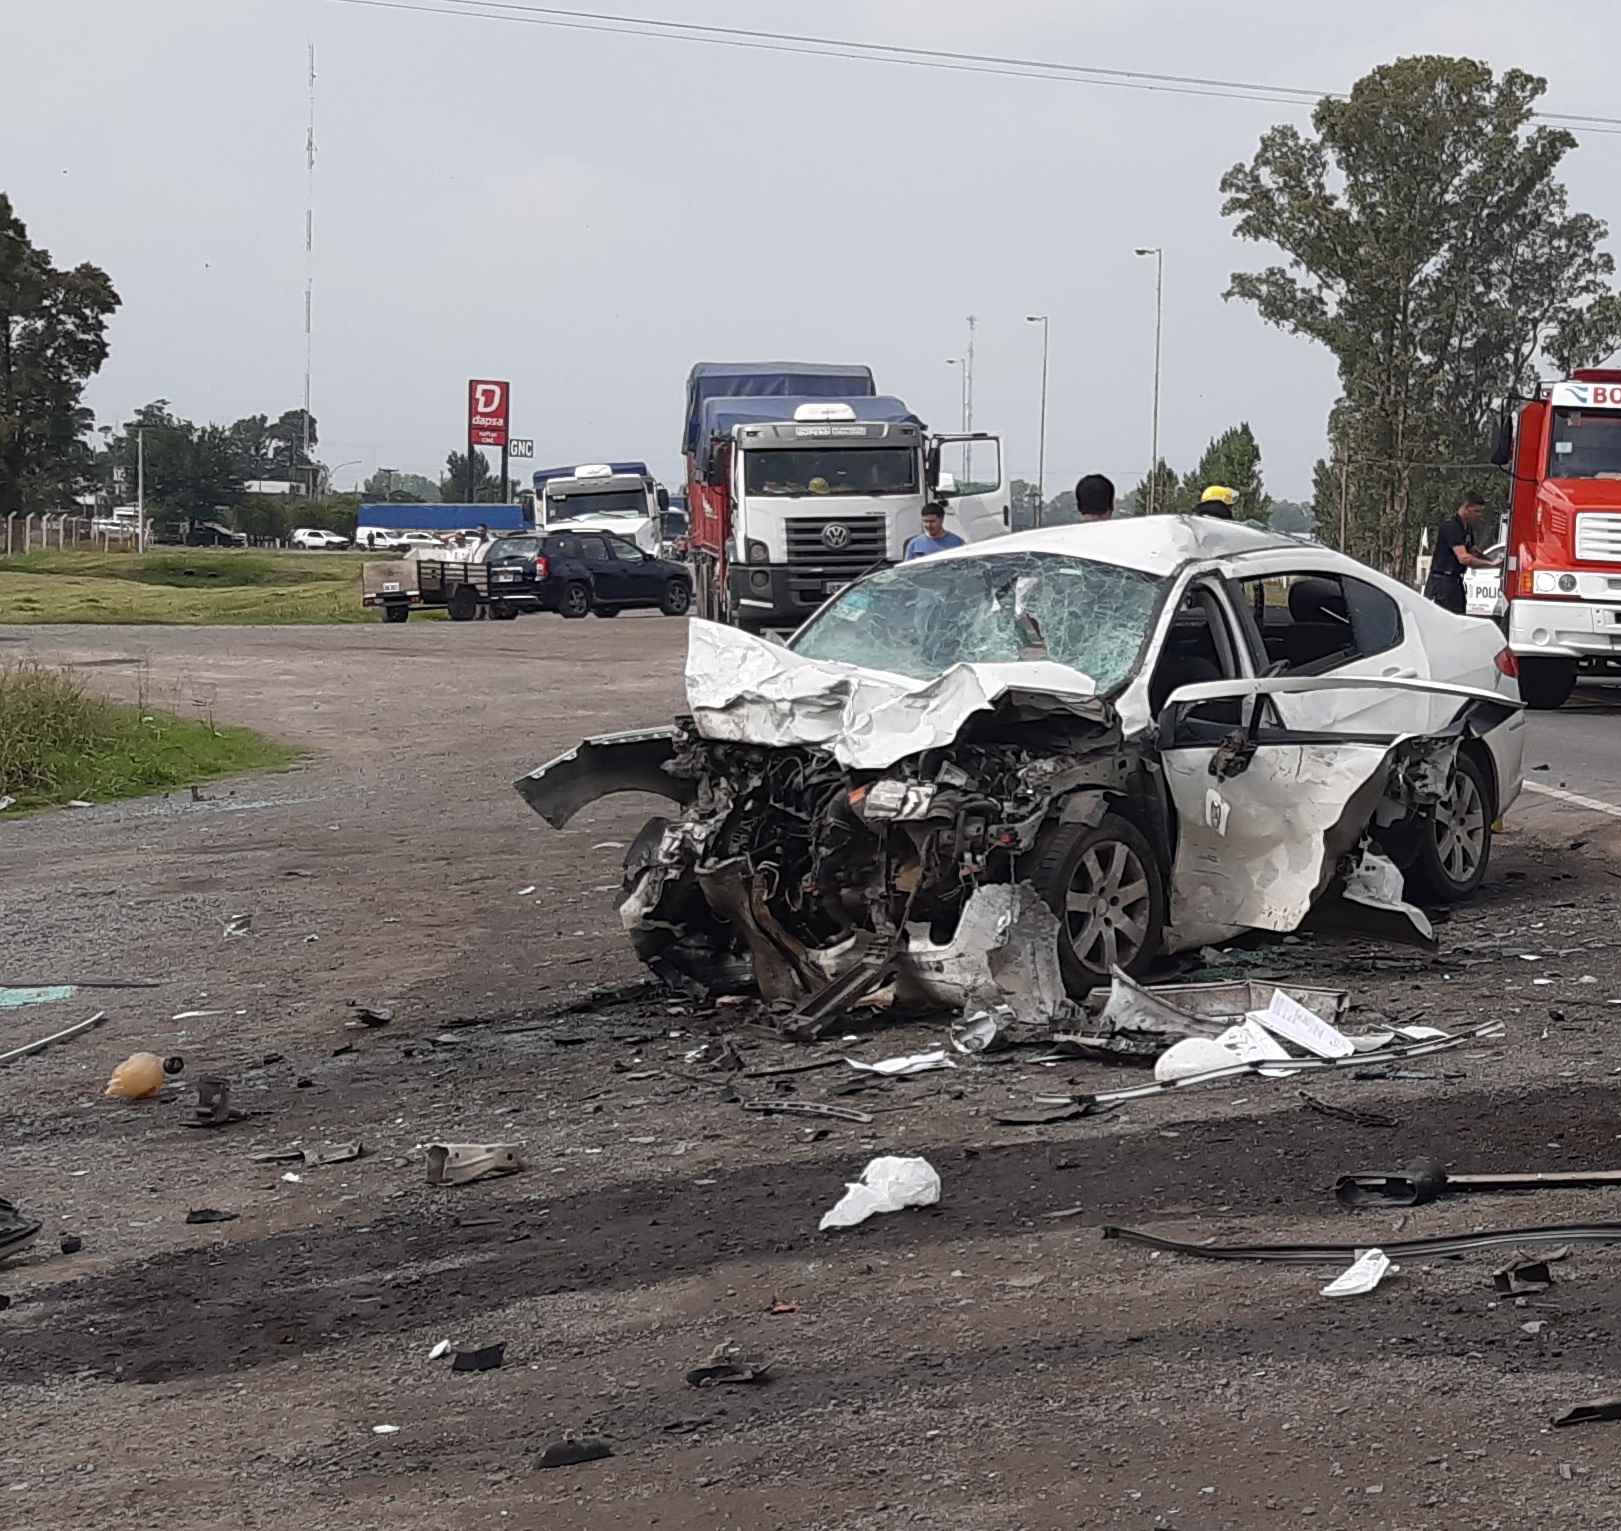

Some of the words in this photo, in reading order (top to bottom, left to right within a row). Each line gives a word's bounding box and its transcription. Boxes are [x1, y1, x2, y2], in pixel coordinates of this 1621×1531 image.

[472, 414, 504, 427] dapsa
[510, 440, 533, 456] GNC
[1476, 586, 1502, 599] POLIC
